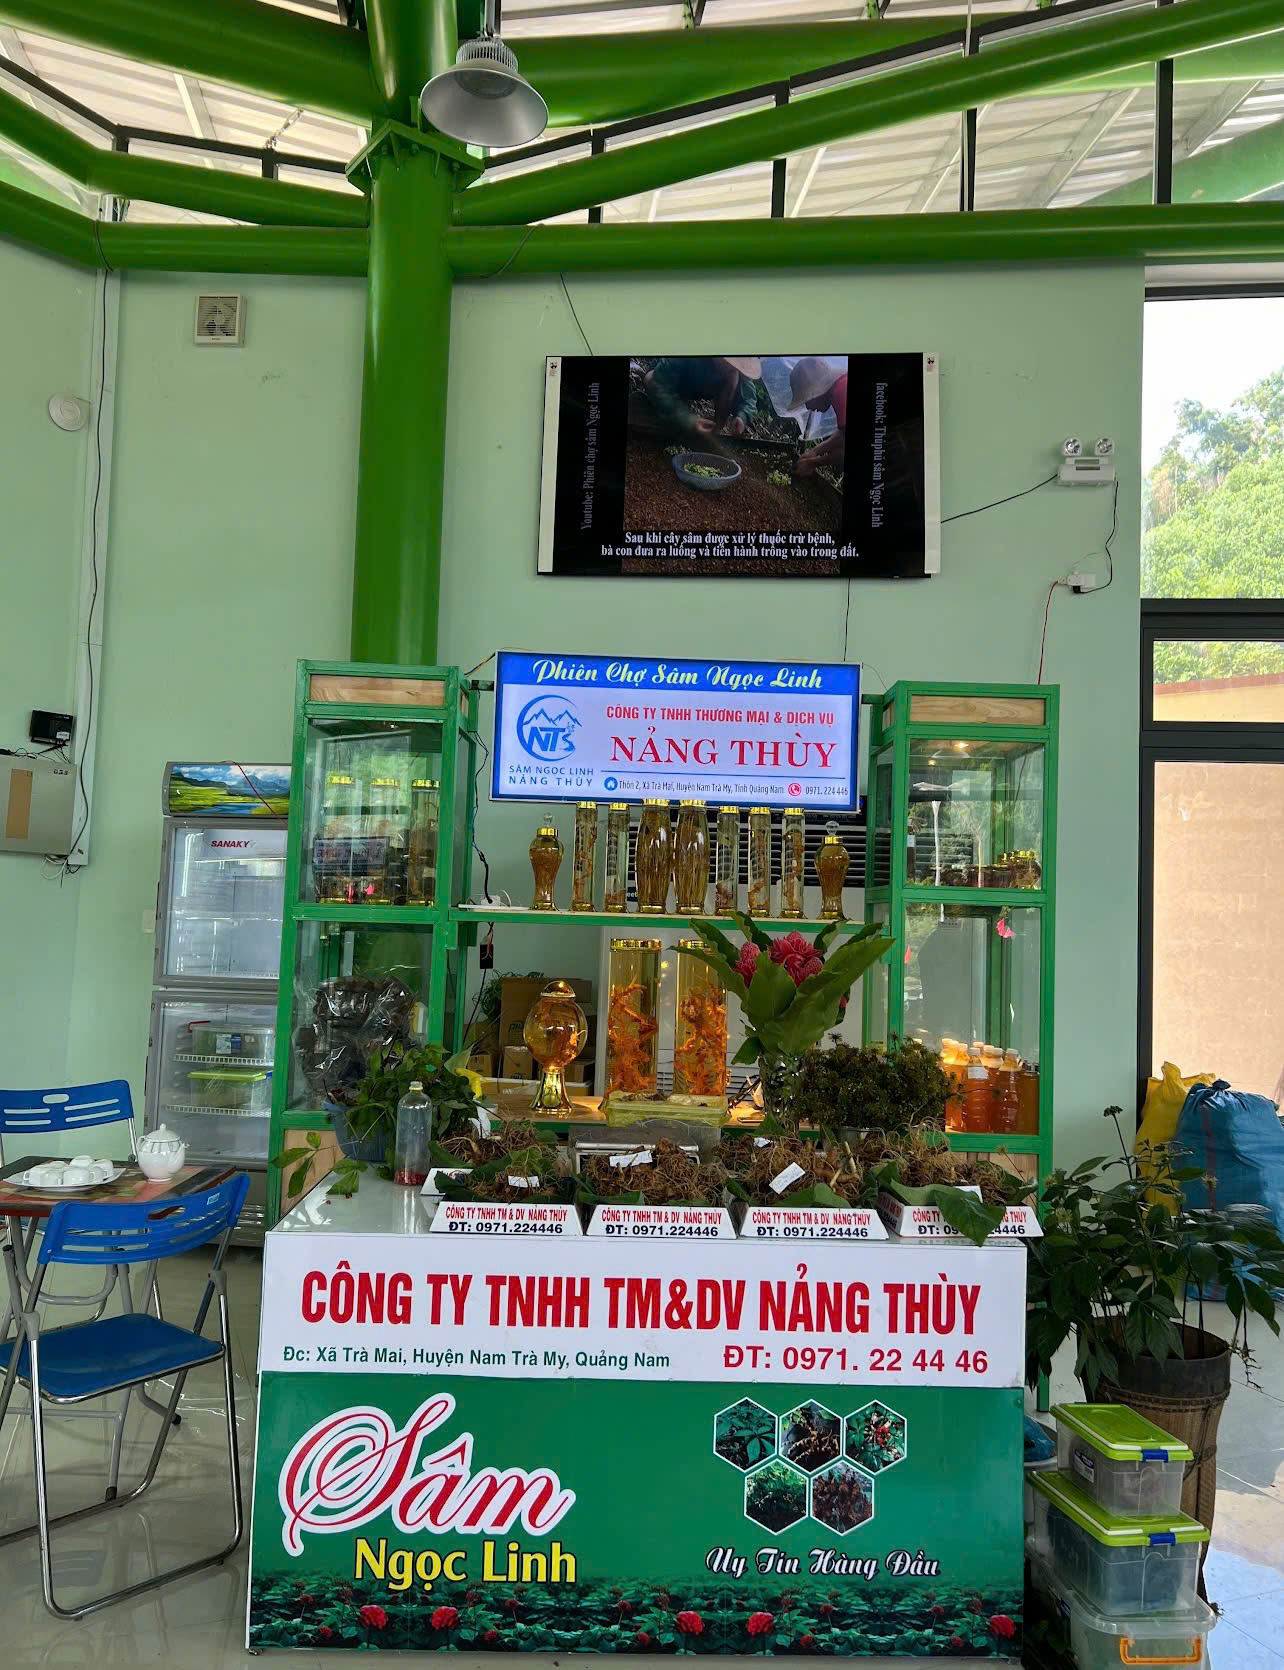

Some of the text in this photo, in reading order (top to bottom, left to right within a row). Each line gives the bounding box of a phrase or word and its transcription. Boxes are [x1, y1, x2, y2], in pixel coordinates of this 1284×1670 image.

[588, 382, 600, 403] Linh
[875, 382, 888, 424] facebook:
[586, 405, 601, 426] Ngọc
[582, 465, 594, 489] Phiên
[872, 462, 886, 480] sâm
[869, 482, 885, 505] Ngọc
[581, 491, 594, 530] Youtube:
[872, 507, 884, 528] Linh
[625, 529, 835, 546] Sau khi cây sâm được xử lý thuốc trừ bệnh,
[601, 544, 613, 556] bà
[616, 548, 632, 556] con
[635, 545, 654, 556] đưa
[656, 547, 666, 556] ra
[699, 545, 710, 556] và
[734, 545, 758, 556] hành
[761, 543, 788, 559] trồng
[791, 545, 808, 556] vào
[810, 547, 837, 559] trong
[840, 543, 859, 557] đất.
[532, 659, 823, 690] Phiên Chợ Sâm Ngọc Linh
[607, 704, 834, 727] CÔNG TY TNHH THƯƠNG MẠI & DỊCH VỤ
[527, 726, 576, 752] NTS
[610, 726, 837, 767] NẢNG THÙY
[509, 774, 593, 787] NẢNG THÙY
[635, 780, 641, 790] 2,
[697, 782, 710, 791] Nam
[712, 783, 721, 792] Trà
[723, 783, 733, 793] My,
[770, 785, 784, 794] Nam
[446, 1204, 567, 1221] CÔNG TY TNHH TM & DV NẢNG THÙY
[602, 1208, 722, 1224] CÔNG TY TNHH TM & DV NẢNG THÙY
[753, 1209, 770, 1224] CÔNG
[773, 1212, 781, 1224] TY
[783, 1212, 800, 1224] TNHH
[803, 1213, 812, 1224] TM
[814, 1214, 818, 1224] &
[821, 1214, 829, 1224] DV
[853, 1211, 870, 1225] THÙY
[913, 1208, 930, 1222] CÔNG
[933, 1211, 940, 1222] TY
[449, 1222, 562, 1233] ĐT: 0971.224446
[606, 1225, 718, 1236] ĐT: 0971.224446
[757, 1227, 868, 1237] ĐT: 0971.224446
[918, 1226, 939, 1234] ĐT:
[301, 1260, 981, 1336] CÔNG TY TNHH TM&DV NẢNG THÙY
[283, 1346, 670, 1371] Đc: Xã Trà Mai, Huyện Nam Trà My, Quảng Nam
[724, 1346, 988, 1374] ĐT: 0971. 22 44 46
[279, 1392, 576, 1557] Sâm
[355, 1538, 577, 1591] Ngọc Linh
[706, 1547, 940, 1581] Uy Tín Hàng Đầu
